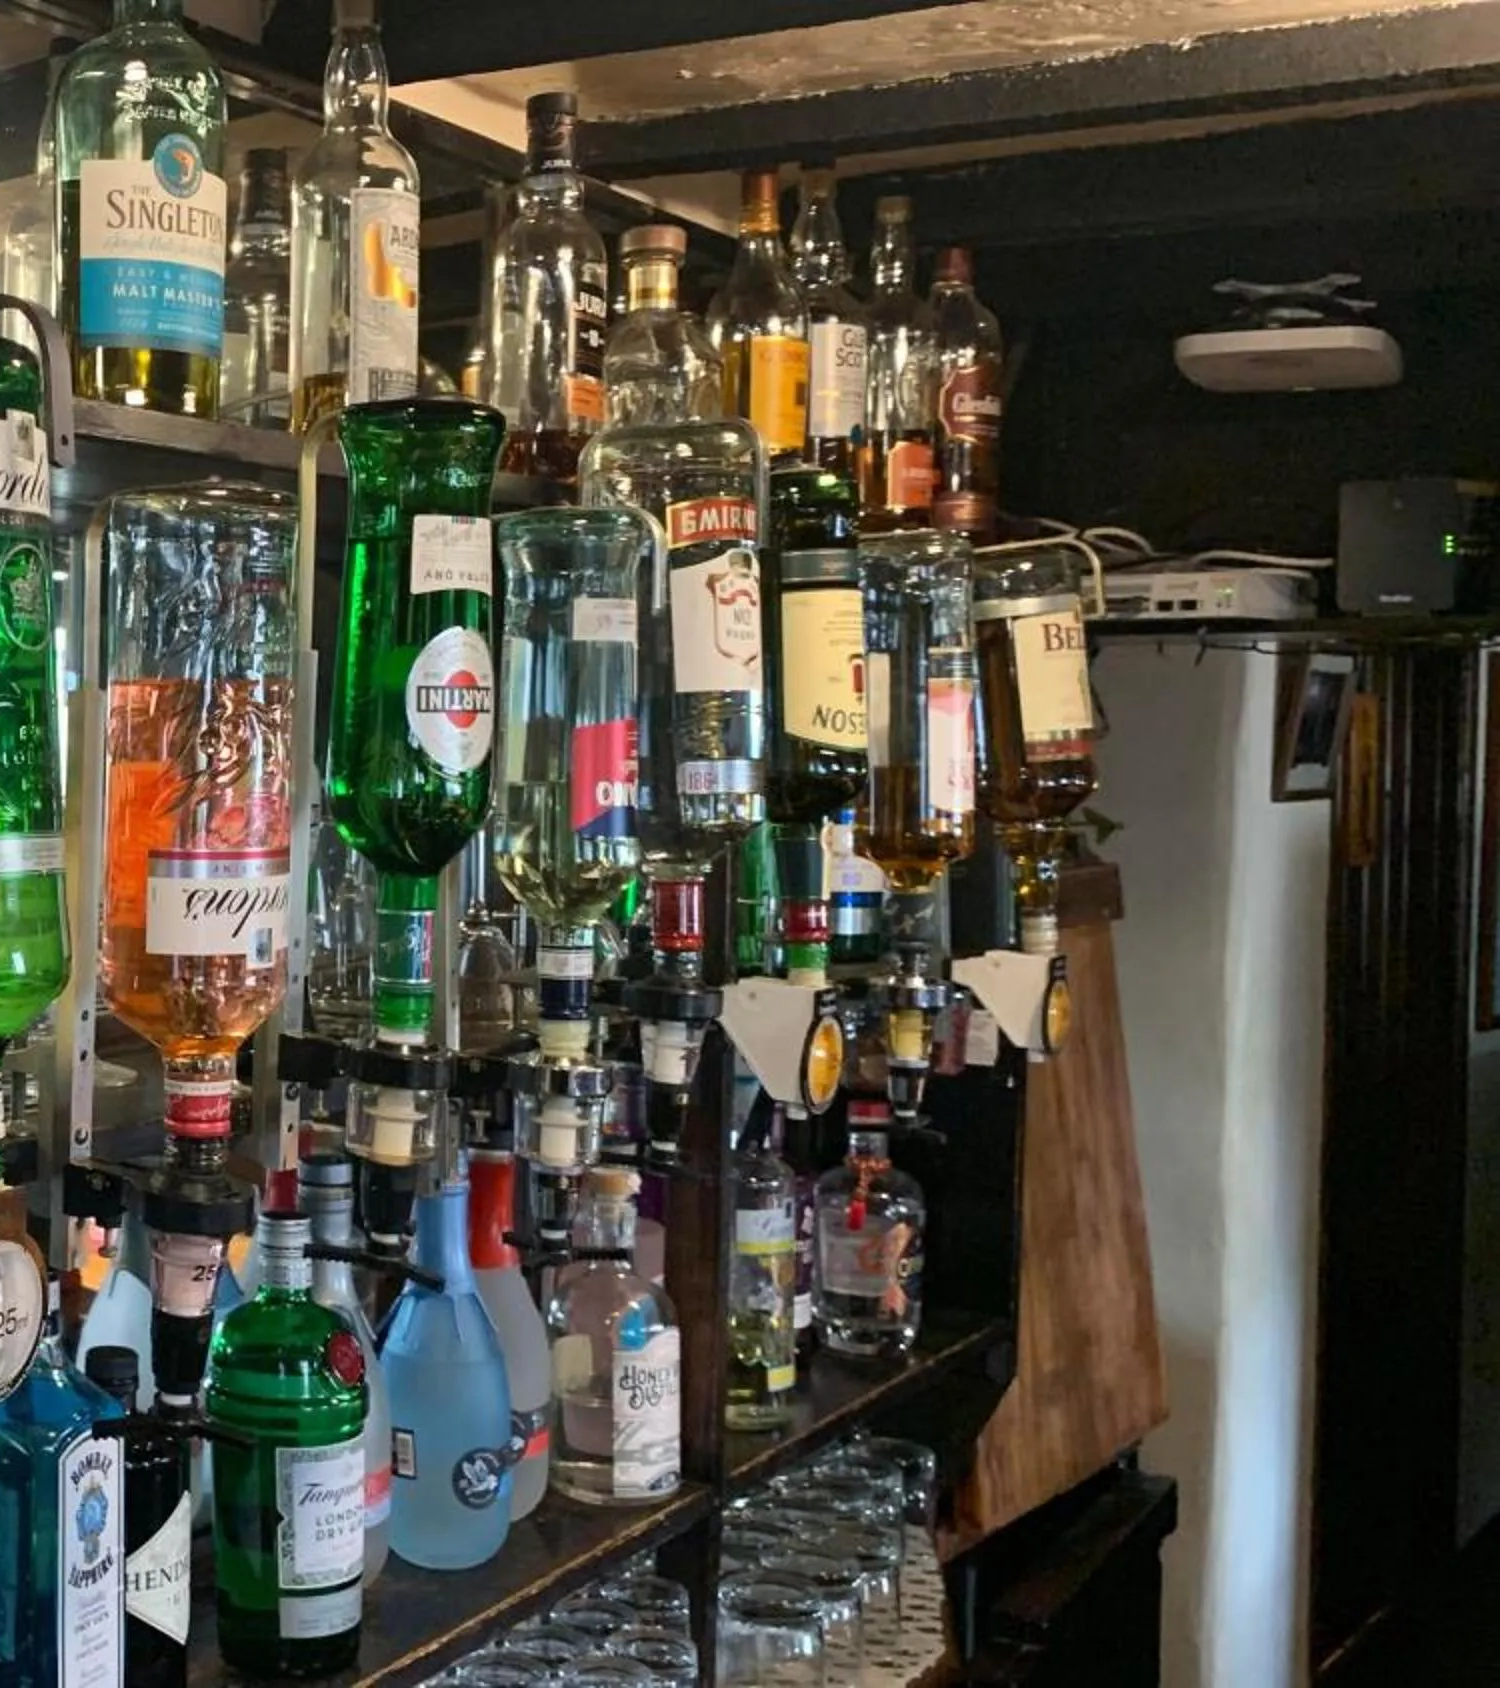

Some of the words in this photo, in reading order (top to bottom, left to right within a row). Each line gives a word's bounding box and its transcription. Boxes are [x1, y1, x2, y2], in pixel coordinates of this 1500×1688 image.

[112, 282, 159, 299] MALT
[182, 886, 289, 940] rdon's
[69, 1451, 114, 1491] BOMBAY
[67, 1548, 115, 1590] SAPPHIRE
